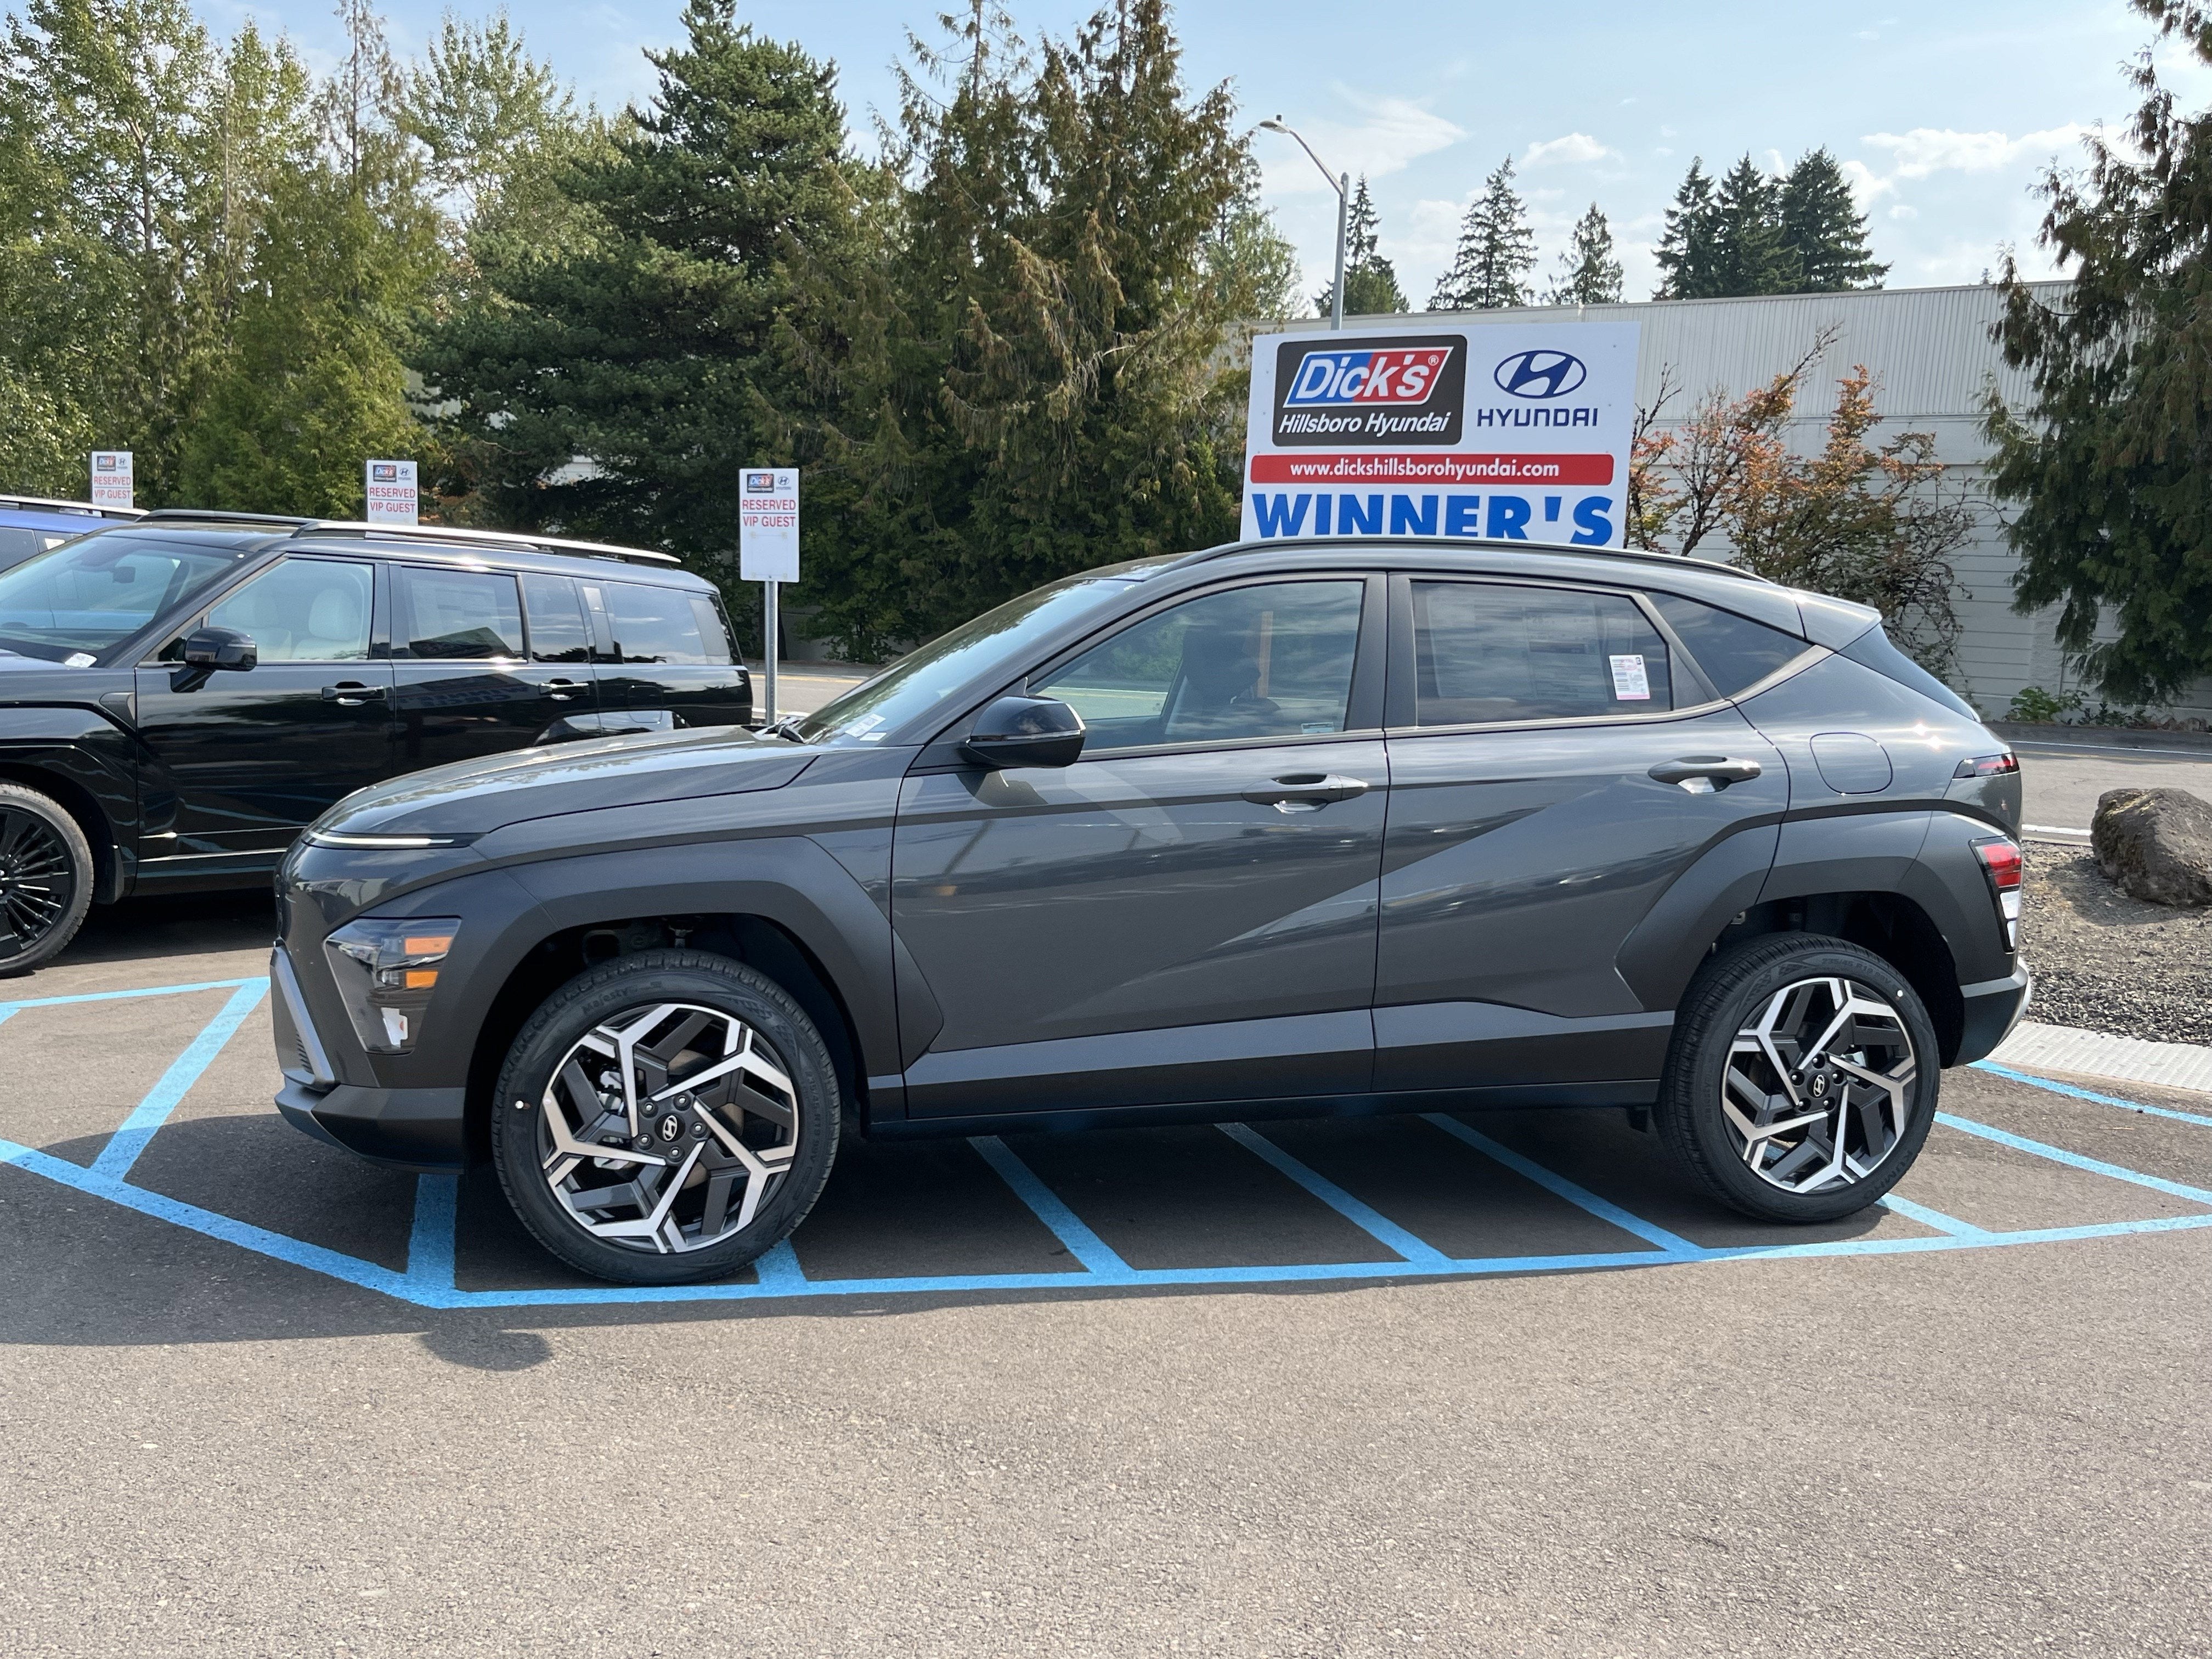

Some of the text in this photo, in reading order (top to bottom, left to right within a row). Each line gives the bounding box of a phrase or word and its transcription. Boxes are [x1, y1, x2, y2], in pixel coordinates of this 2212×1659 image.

[1477, 408, 1598, 427] HYUNDAI
[1278, 412, 1452, 437] Hillsboro Hyundai
[1290, 457, 1559, 481] www.dickshillsborohyundai.com
[94, 476, 131, 486] RESERVED
[94, 489, 131, 499] VIP GUEST
[369, 487, 415, 498] RESERVED
[370, 501, 416, 513] VIP GUEST
[742, 499, 796, 510] RESERVED
[743, 516, 796, 527] VIP GUEST
[1252, 494, 1613, 546] WINNER'S
